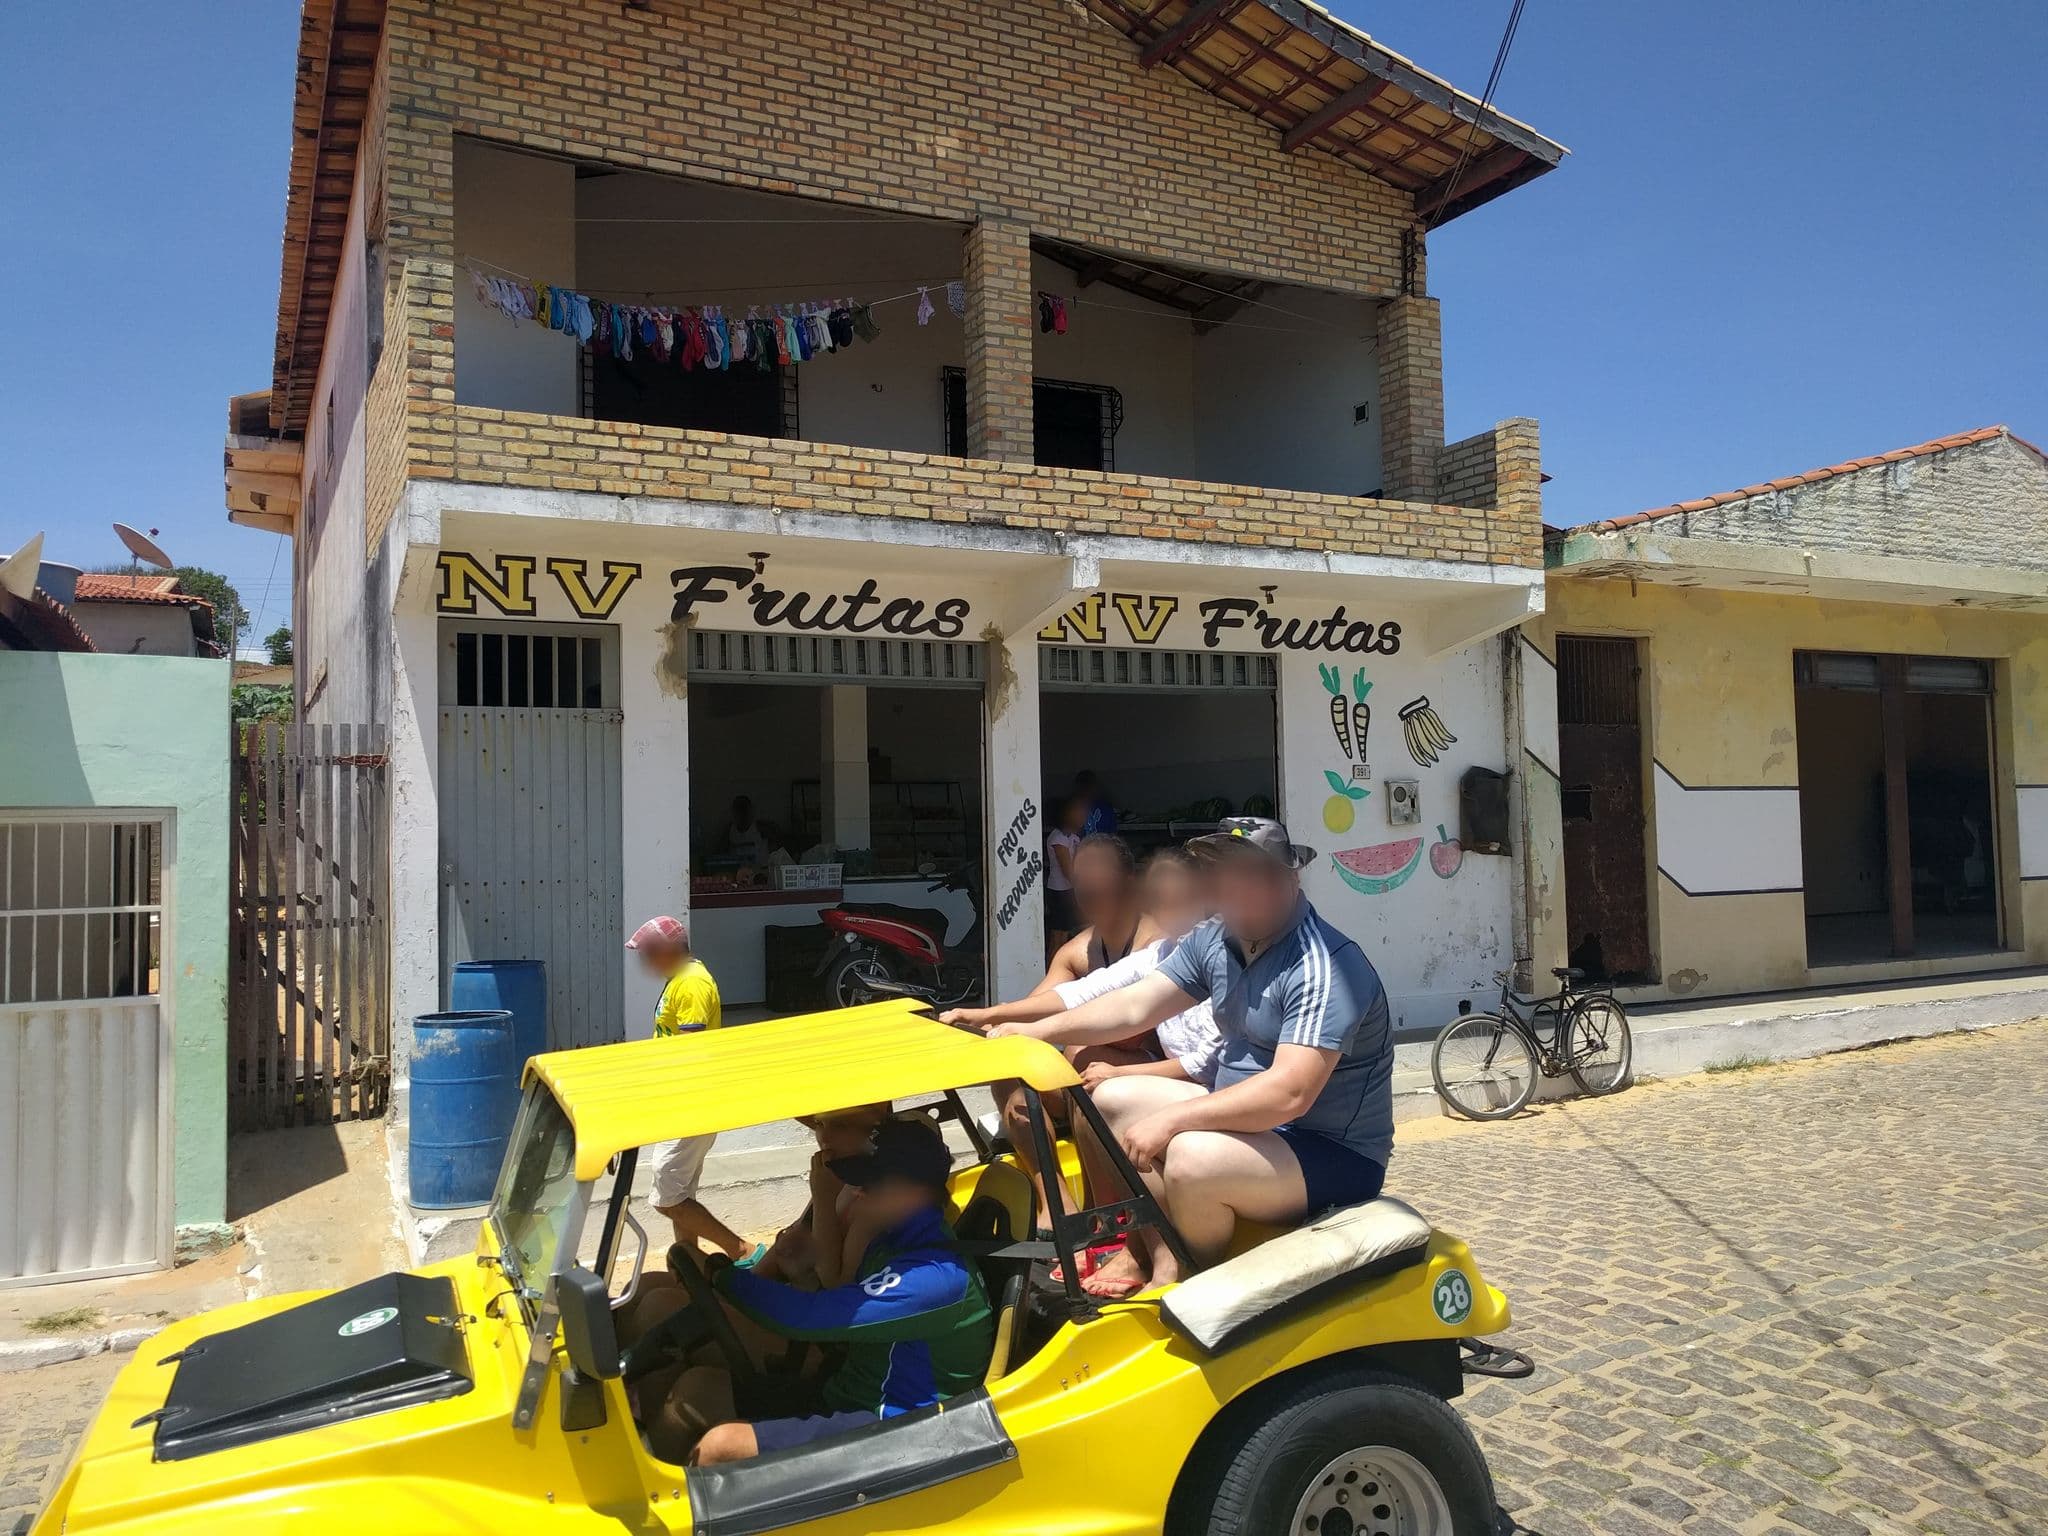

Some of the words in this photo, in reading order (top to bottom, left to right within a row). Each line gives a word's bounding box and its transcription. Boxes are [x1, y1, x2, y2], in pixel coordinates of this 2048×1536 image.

[436, 550, 642, 621] NV
[670, 565, 971, 638] Frutas
[1037, 592, 1179, 644] NV
[1200, 597, 1402, 656] Frutas
[997, 798, 1037, 867] FRUTAS
[996, 851, 1043, 931] VERDURAS
[1438, 1278, 1469, 1319] 28
